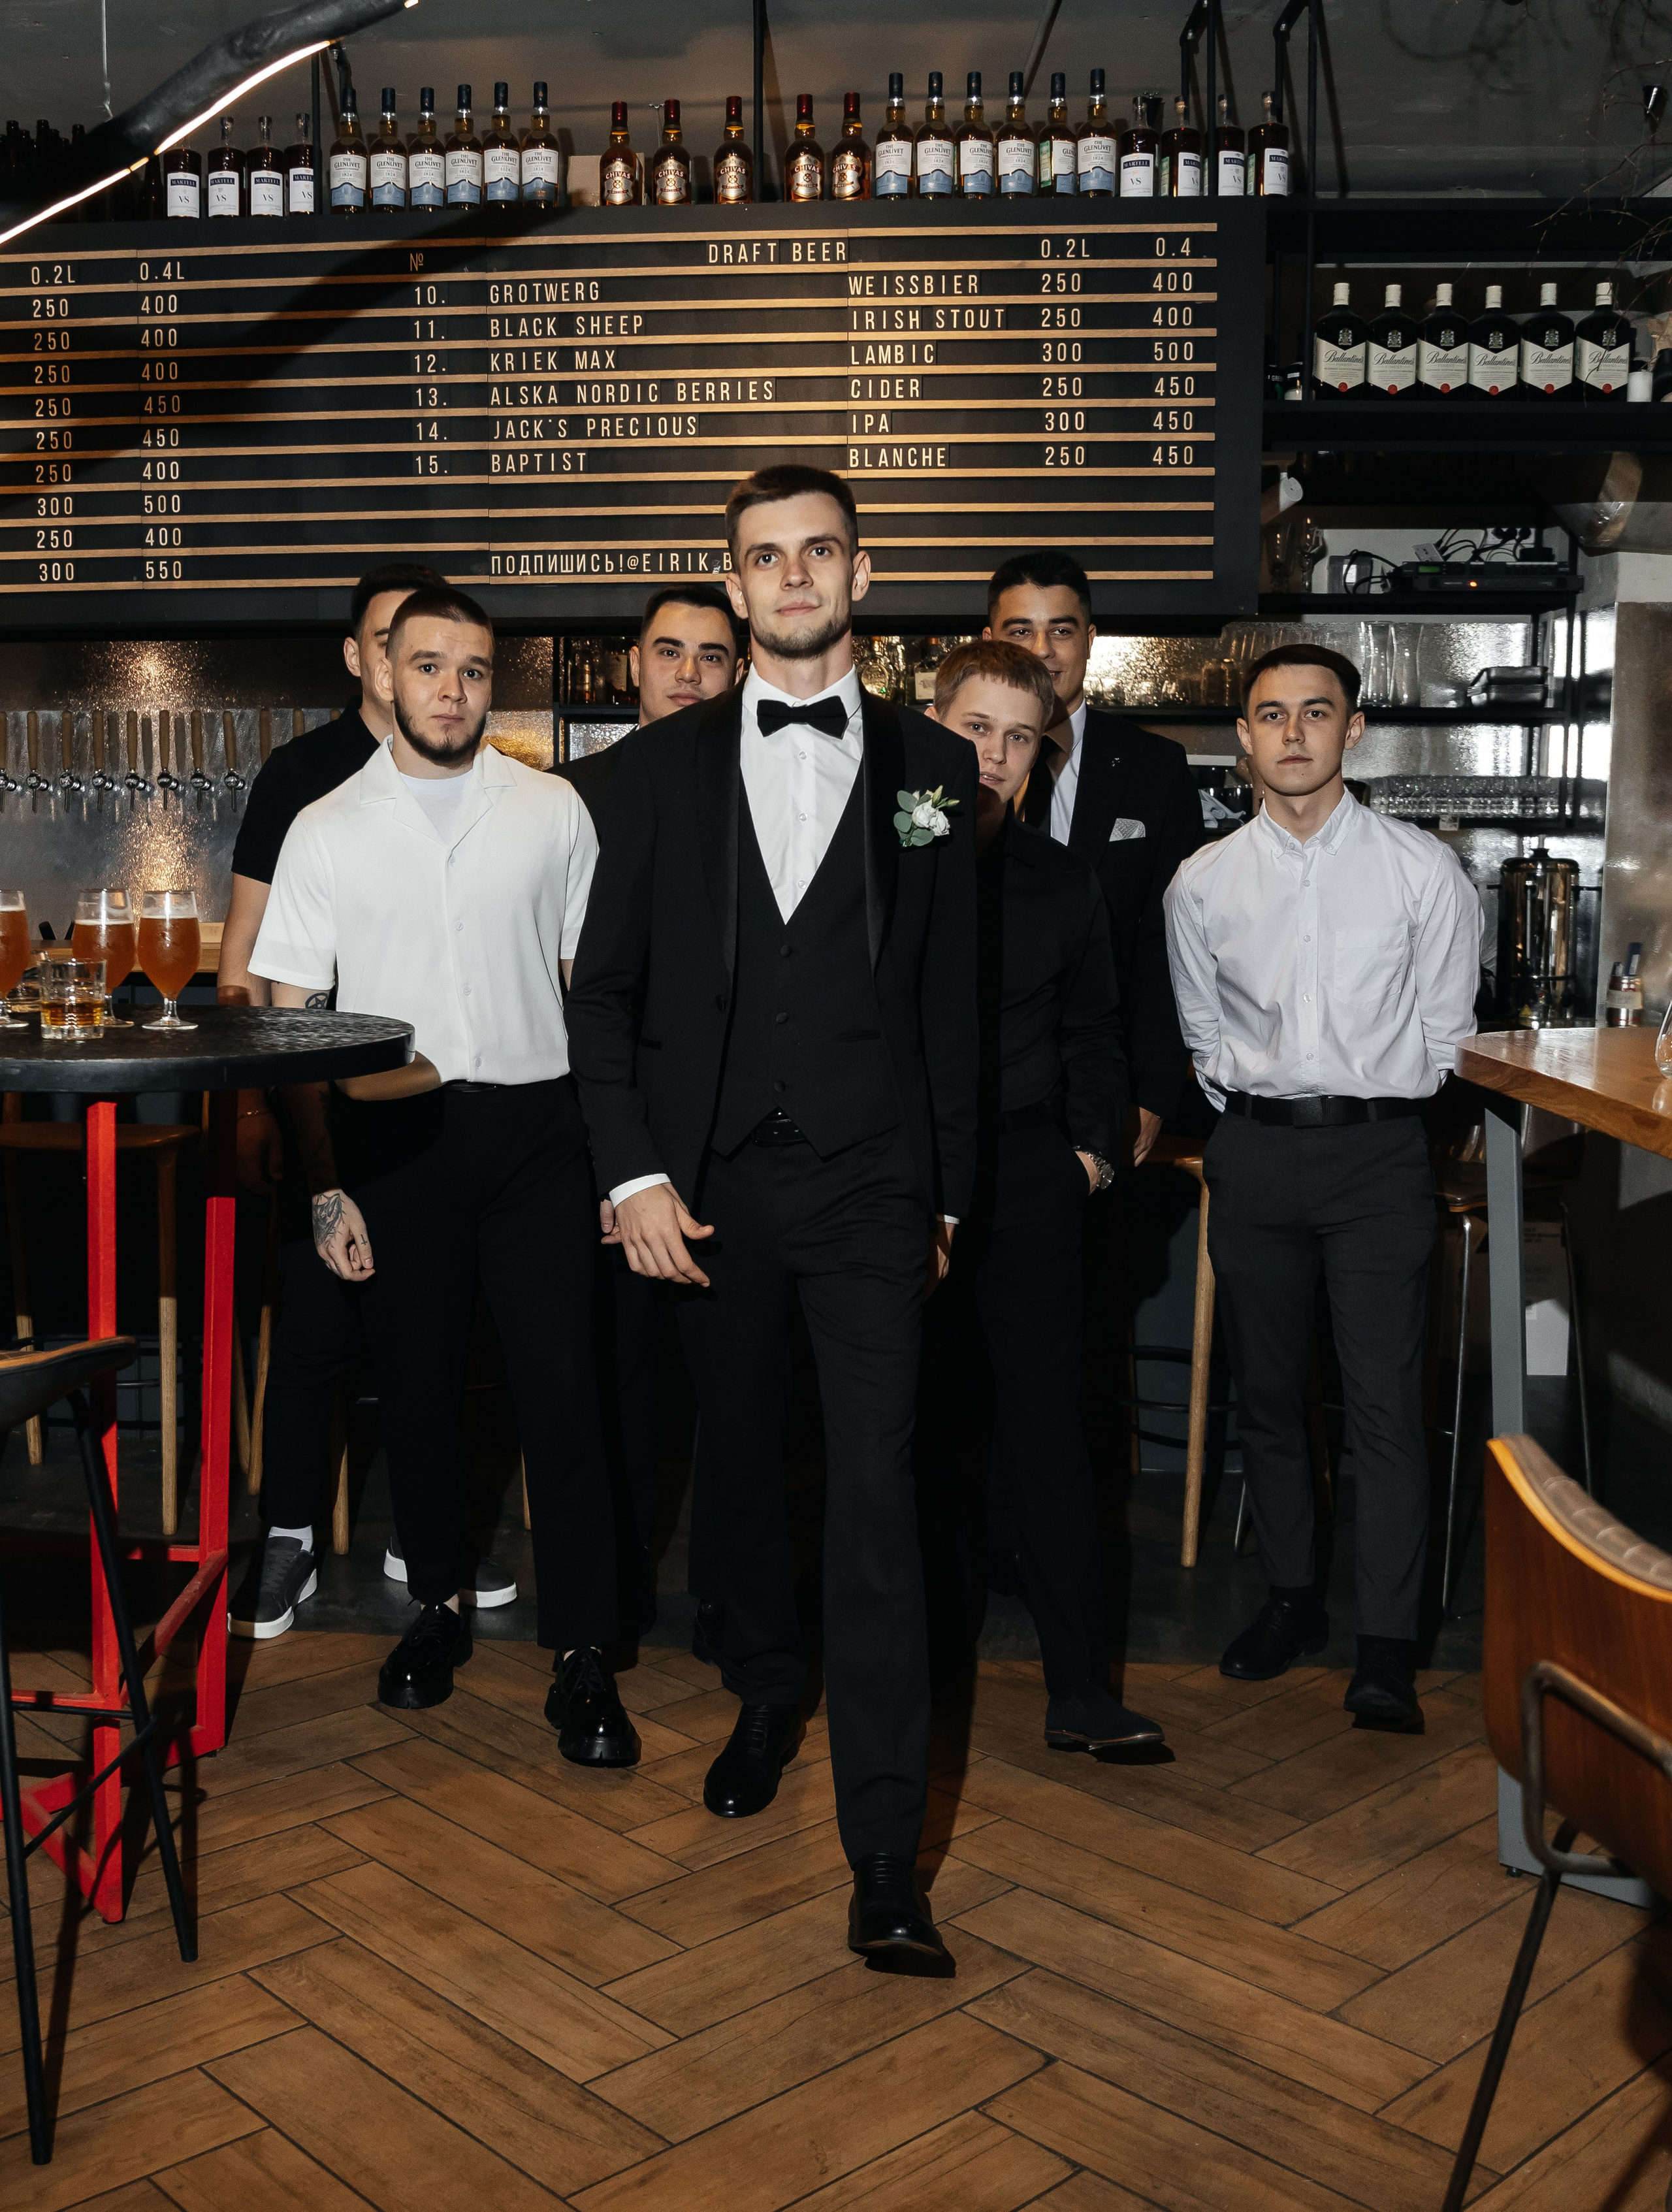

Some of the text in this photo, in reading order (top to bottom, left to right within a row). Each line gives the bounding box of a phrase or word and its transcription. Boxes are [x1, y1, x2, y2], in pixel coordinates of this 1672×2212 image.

[605, 171, 631, 180] CHIVAS
[720, 166, 746, 174] CHIVAS
[794, 164, 820, 173] CHIVAS
[833, 163, 856, 173] CHIVAS
[1130, 177, 1142, 186] VS
[709, 242, 777, 264] DRAFT
[792, 242, 846, 262] BEER
[1041, 238, 1090, 258] 0.2L
[1156, 237, 1191, 257] 0.4
[31, 261, 185, 285] 0.2L 0.4L
[415, 272, 1192, 305] 10. GROTWERG WEISSBIER 250 400
[33, 294, 177, 317] 250 400
[414, 306, 1192, 339] 11. BLACK SHEEP IRISH STOUT 250 400
[34, 328, 177, 351] 250 400
[414, 342, 1193, 373] 12. KRIEK MAX LAMBIC 300 500
[35, 362, 178, 384] 250 400
[416, 376, 1194, 406] 13. ALSKA NORDIC BERRIES CIDER 250 450
[35, 395, 180, 417] 250 450
[417, 421, 447, 441] 14.
[587, 415, 698, 437] PRECIOUS
[852, 413, 889, 434] IPA
[1045, 411, 1084, 431] 300
[1153, 411, 1193, 431] 450
[36, 428, 179, 450] 250 450
[415, 446, 1193, 474] 15. BAPTIST BLANCHE 250 450
[35, 461, 179, 483] 250 400
[37, 495, 180, 516] 300 500
[37, 527, 181, 549] 250 400
[39, 561, 182, 581] 300 550
